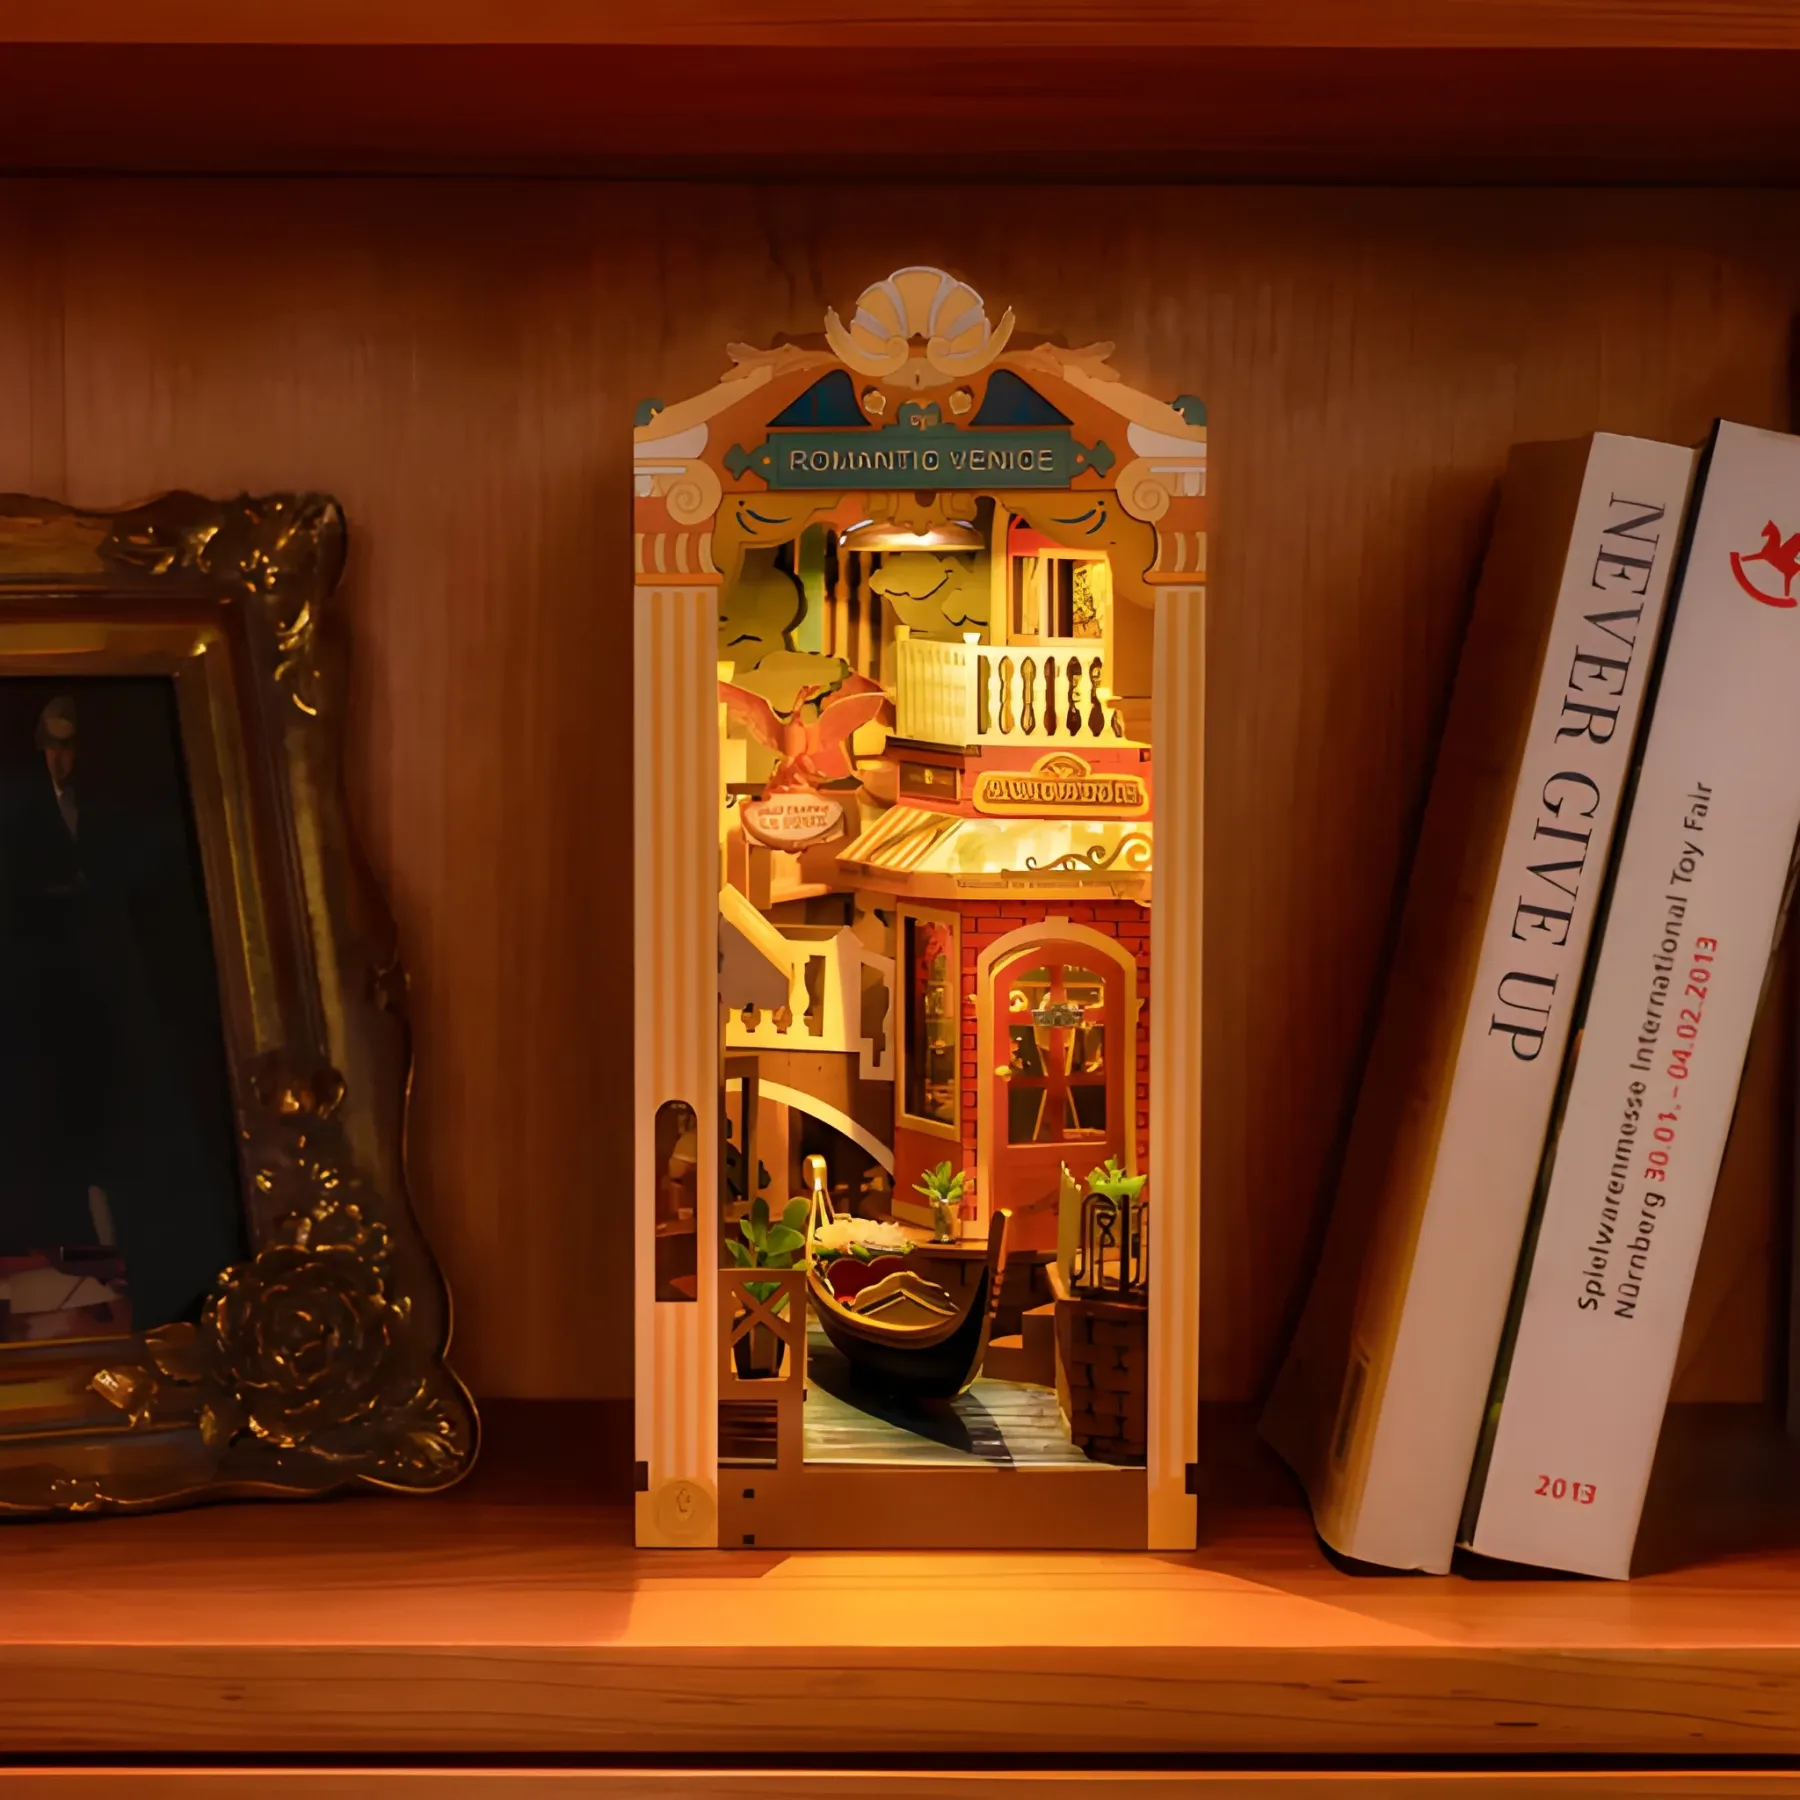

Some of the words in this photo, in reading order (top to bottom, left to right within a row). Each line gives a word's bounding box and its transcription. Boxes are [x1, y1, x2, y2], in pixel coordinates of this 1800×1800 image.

[1553, 491, 1667, 745] NEVER
[1682, 781, 1713, 832] Fair
[1511, 770, 1601, 948] GIVE
[1669, 840, 1706, 885] Toy
[1487, 970, 1560, 1063] UP
[1629, 894, 1689, 1072] International
[1535, 1474, 1597, 1506] 2013
